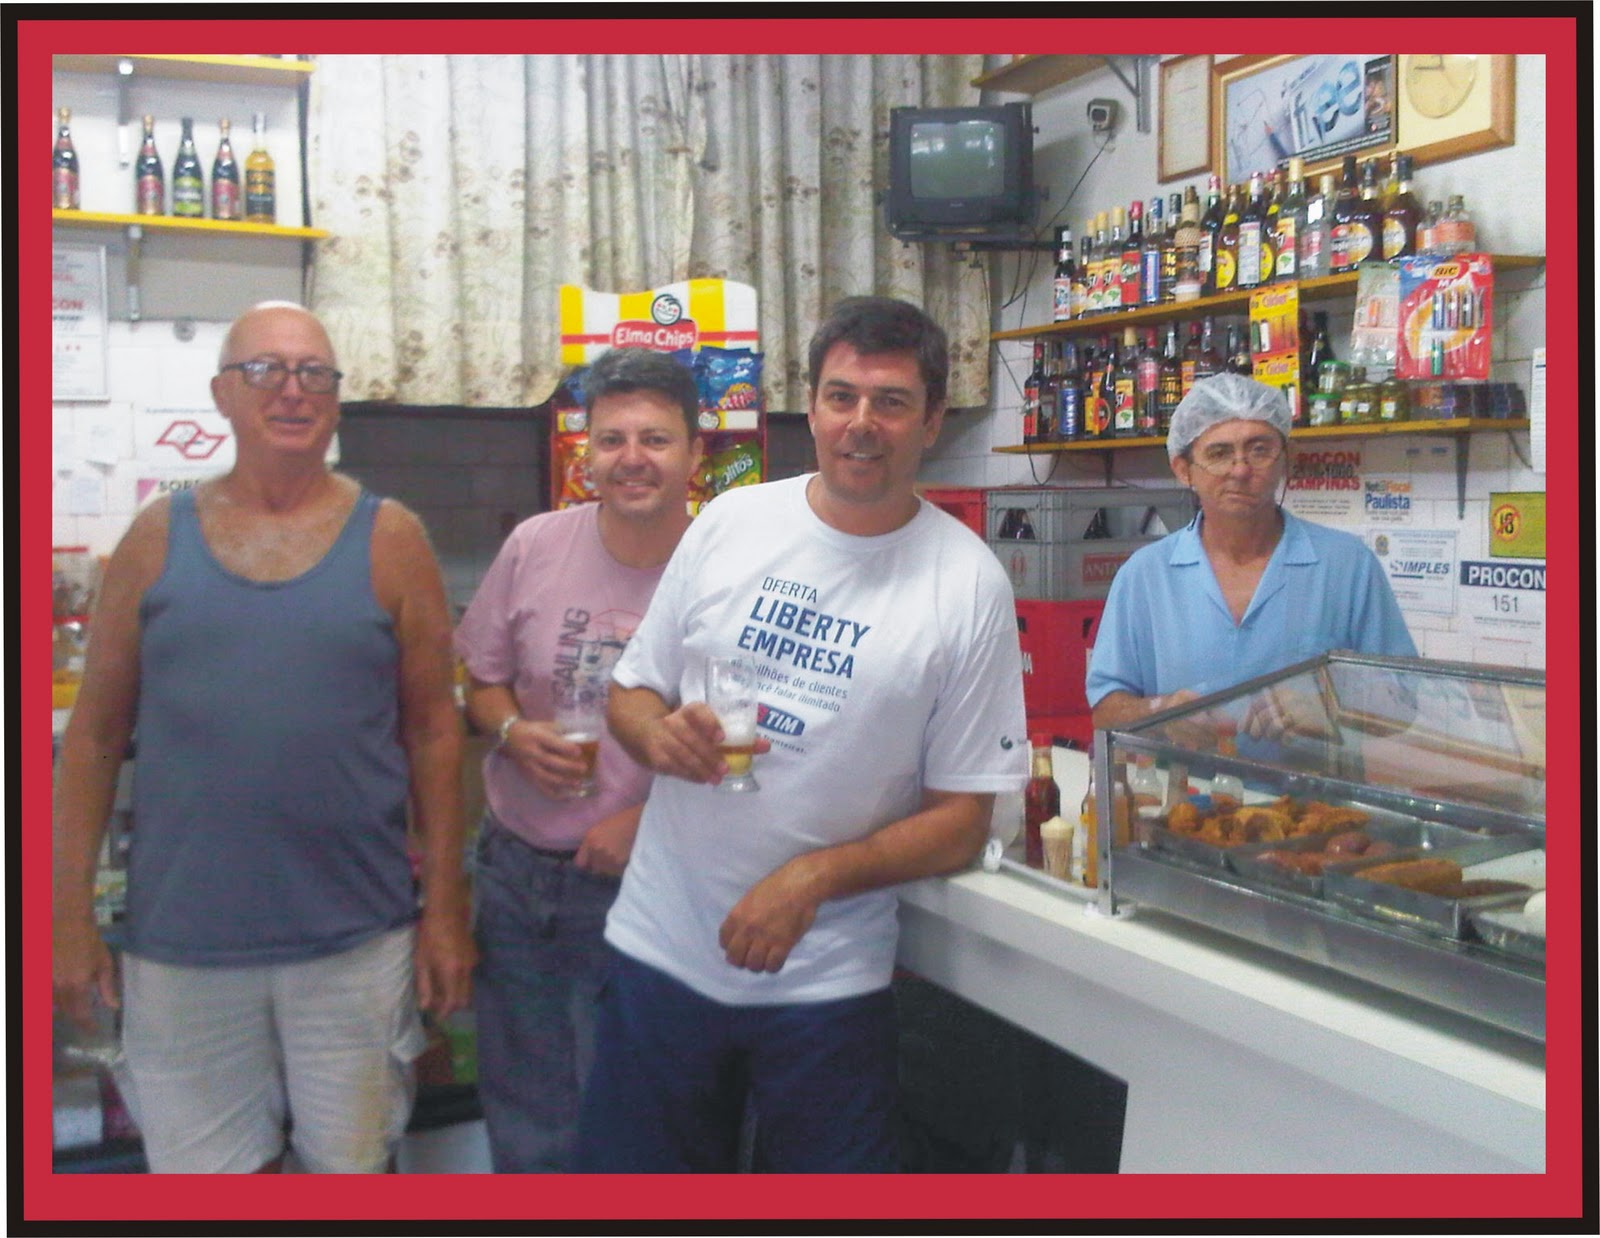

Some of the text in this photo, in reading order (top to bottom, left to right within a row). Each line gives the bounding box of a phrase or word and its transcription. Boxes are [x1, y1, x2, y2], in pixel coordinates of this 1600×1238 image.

[616, 327, 694, 347] Elma Chips
[1287, 477, 1360, 491] CAMPINAS
[1364, 492, 1411, 510] Paulista
[1468, 565, 1546, 589] PROCON
[762, 576, 818, 603] OFERTA
[1492, 594, 1519, 613] 151
[750, 596, 871, 648] LIBERTY
[738, 625, 854, 679] EMPRESA
[793, 676, 806, 689] de
[808, 678, 848, 699] clientes
[765, 709, 799, 734] TIM
